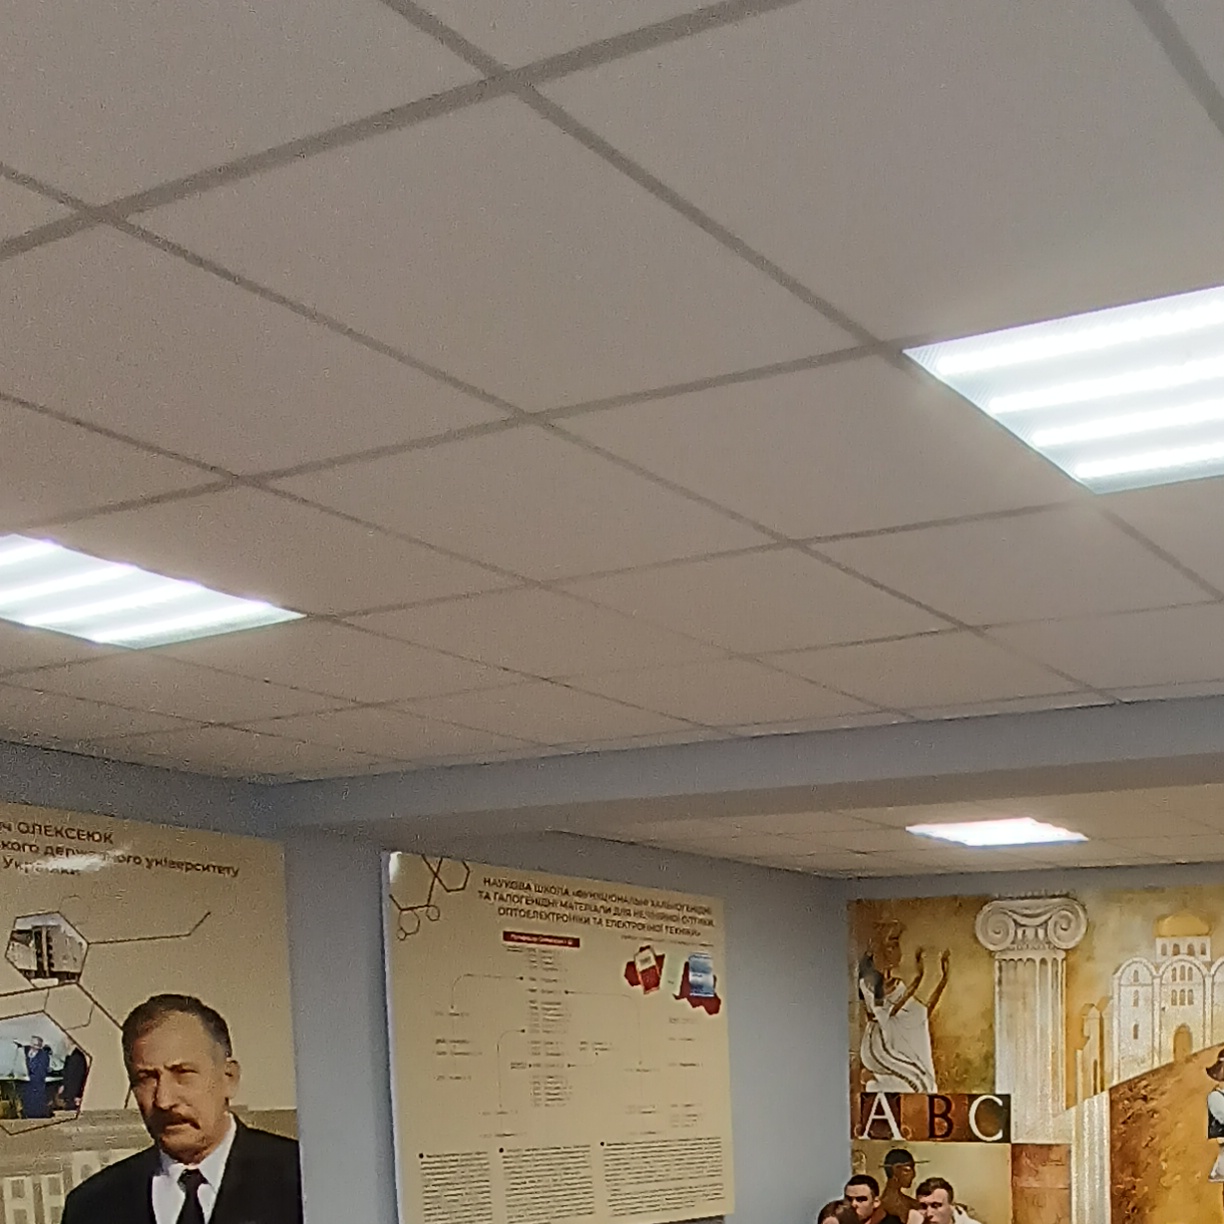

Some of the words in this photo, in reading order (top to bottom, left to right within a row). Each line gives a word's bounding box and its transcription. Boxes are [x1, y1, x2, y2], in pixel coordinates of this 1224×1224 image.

[17, 822, 113, 844] ОЛЕКСЕЮК
[144, 857, 239, 878] університету
[859, 1092, 907, 1140] A
[927, 1094, 954, 1139] B
[968, 1094, 1003, 1142] C
